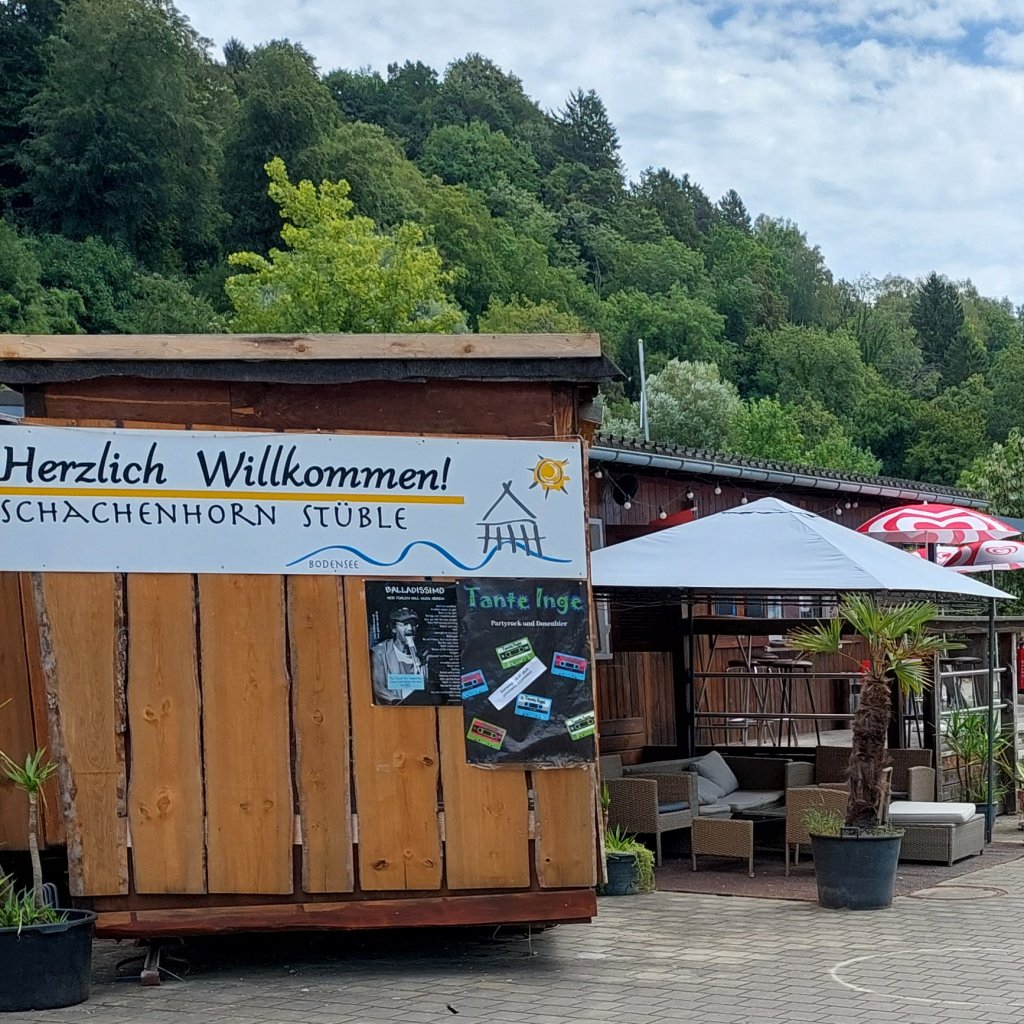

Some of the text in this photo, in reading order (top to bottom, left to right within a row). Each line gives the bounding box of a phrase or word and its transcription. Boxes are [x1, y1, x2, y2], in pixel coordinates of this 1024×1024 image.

[0, 441, 451, 490] Herzlich Willkommen!
[1, 500, 407, 529] SCHACHENHORN STÜBLE
[308, 559, 360, 570] BODENSEE
[385, 586, 445, 595] BALLADISSIMO
[463, 585, 584, 615] Tante Inge
[490, 620, 521, 628] Partyrock
